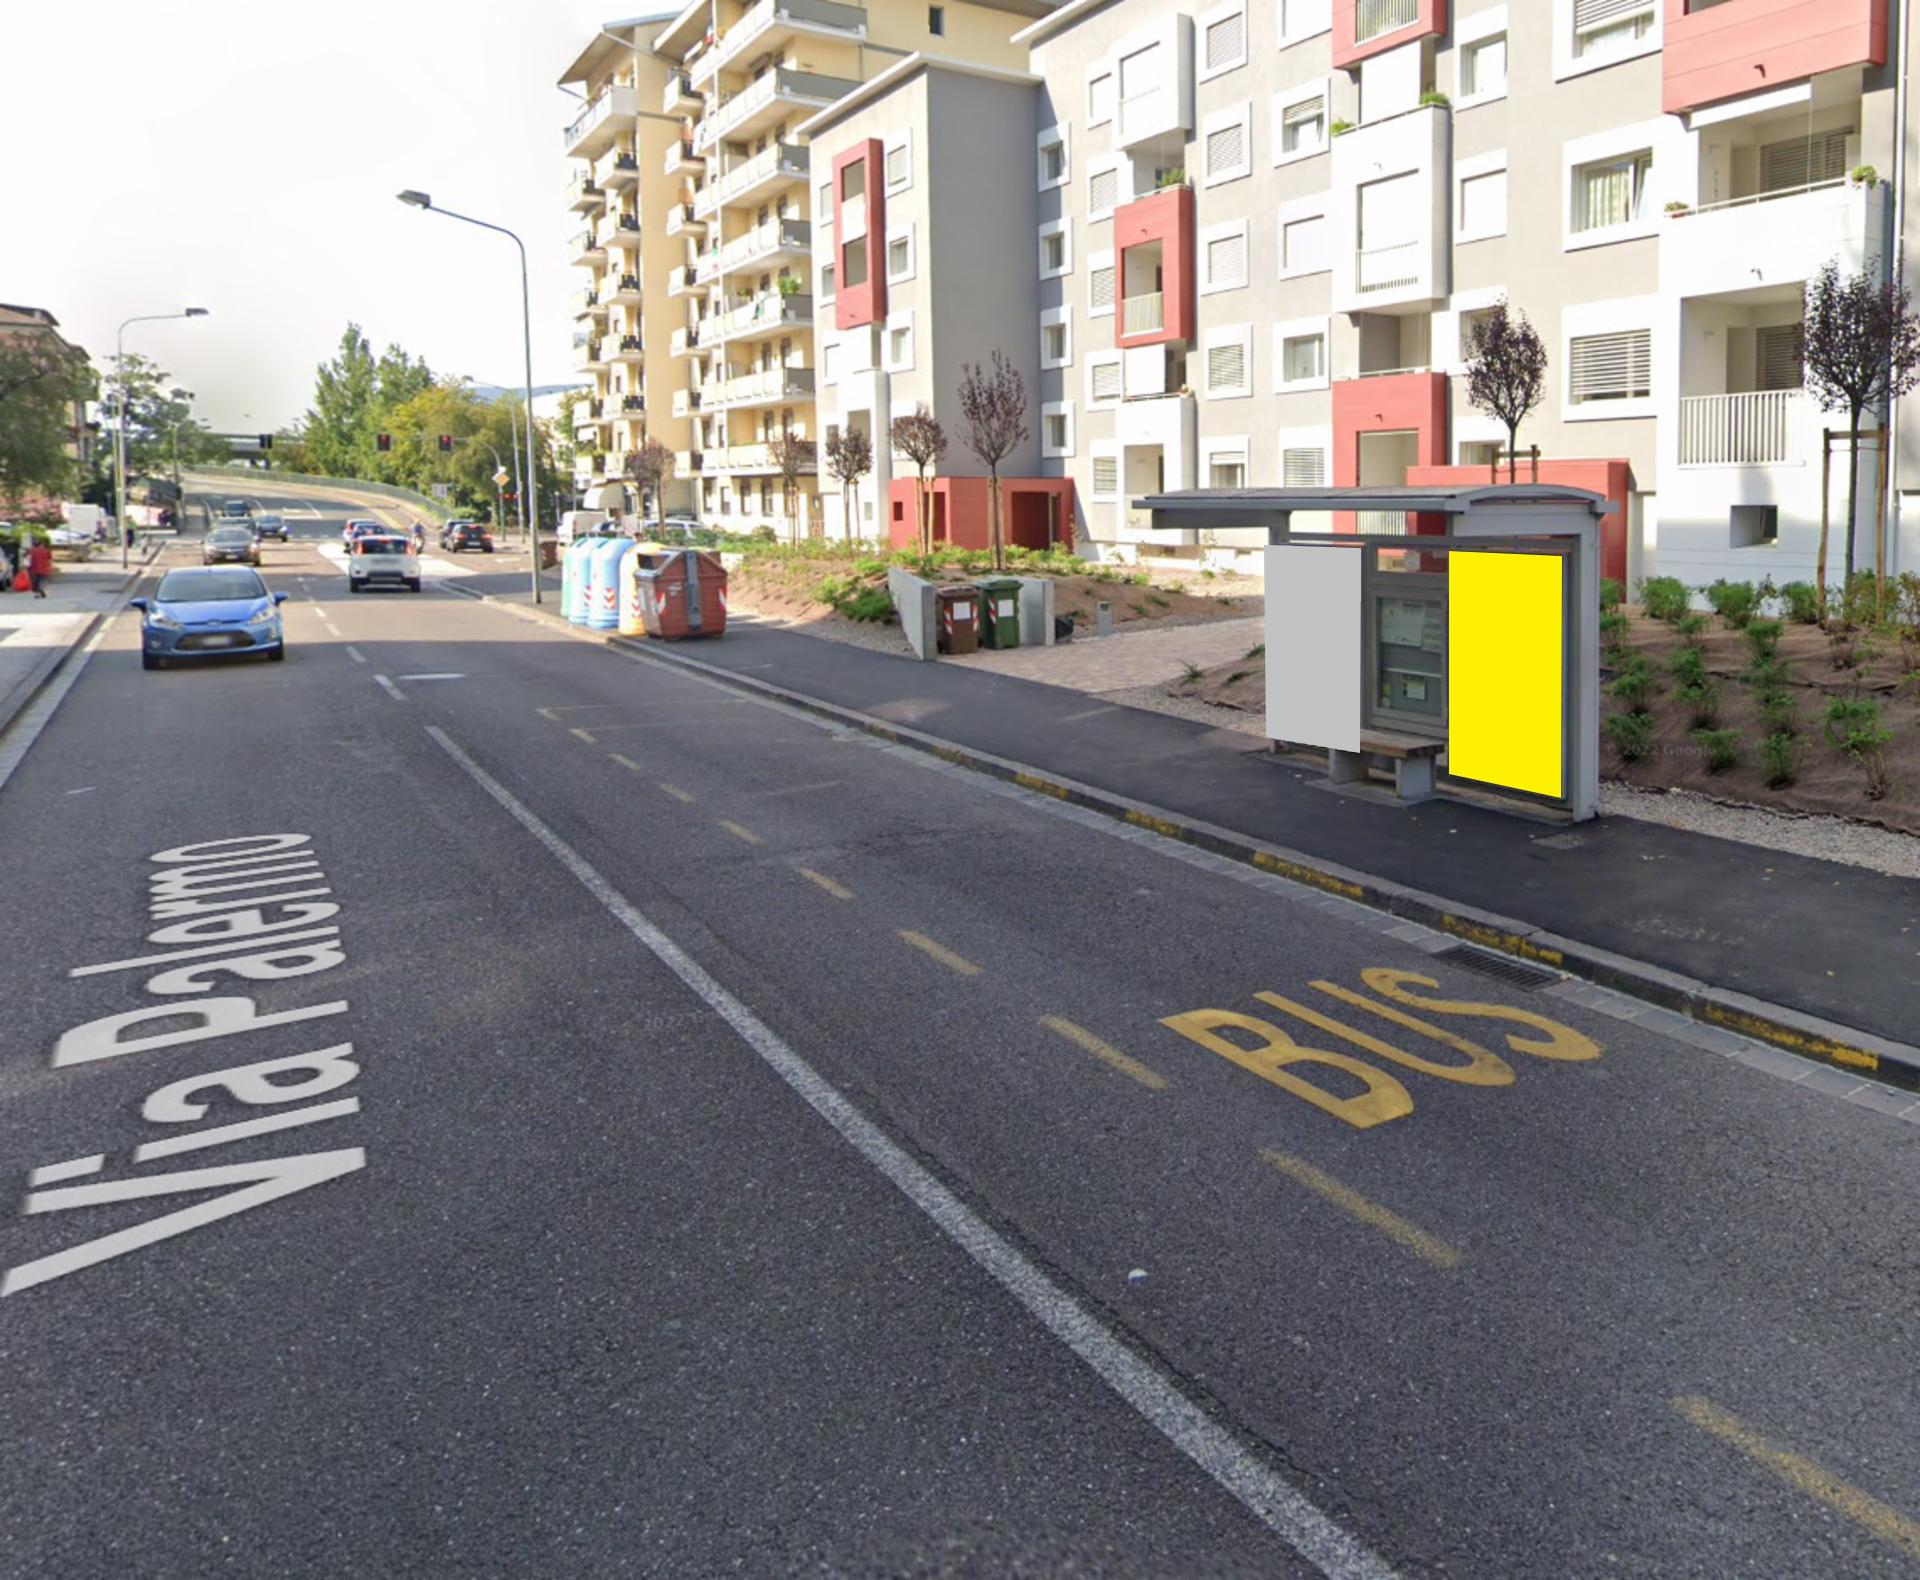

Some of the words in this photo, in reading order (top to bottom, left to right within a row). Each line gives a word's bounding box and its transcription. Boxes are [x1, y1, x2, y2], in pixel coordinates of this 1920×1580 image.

[53, 833, 346, 1068] Palermo
[1158, 967, 1601, 1129] BUS
[0, 1042, 366, 1297] Via
